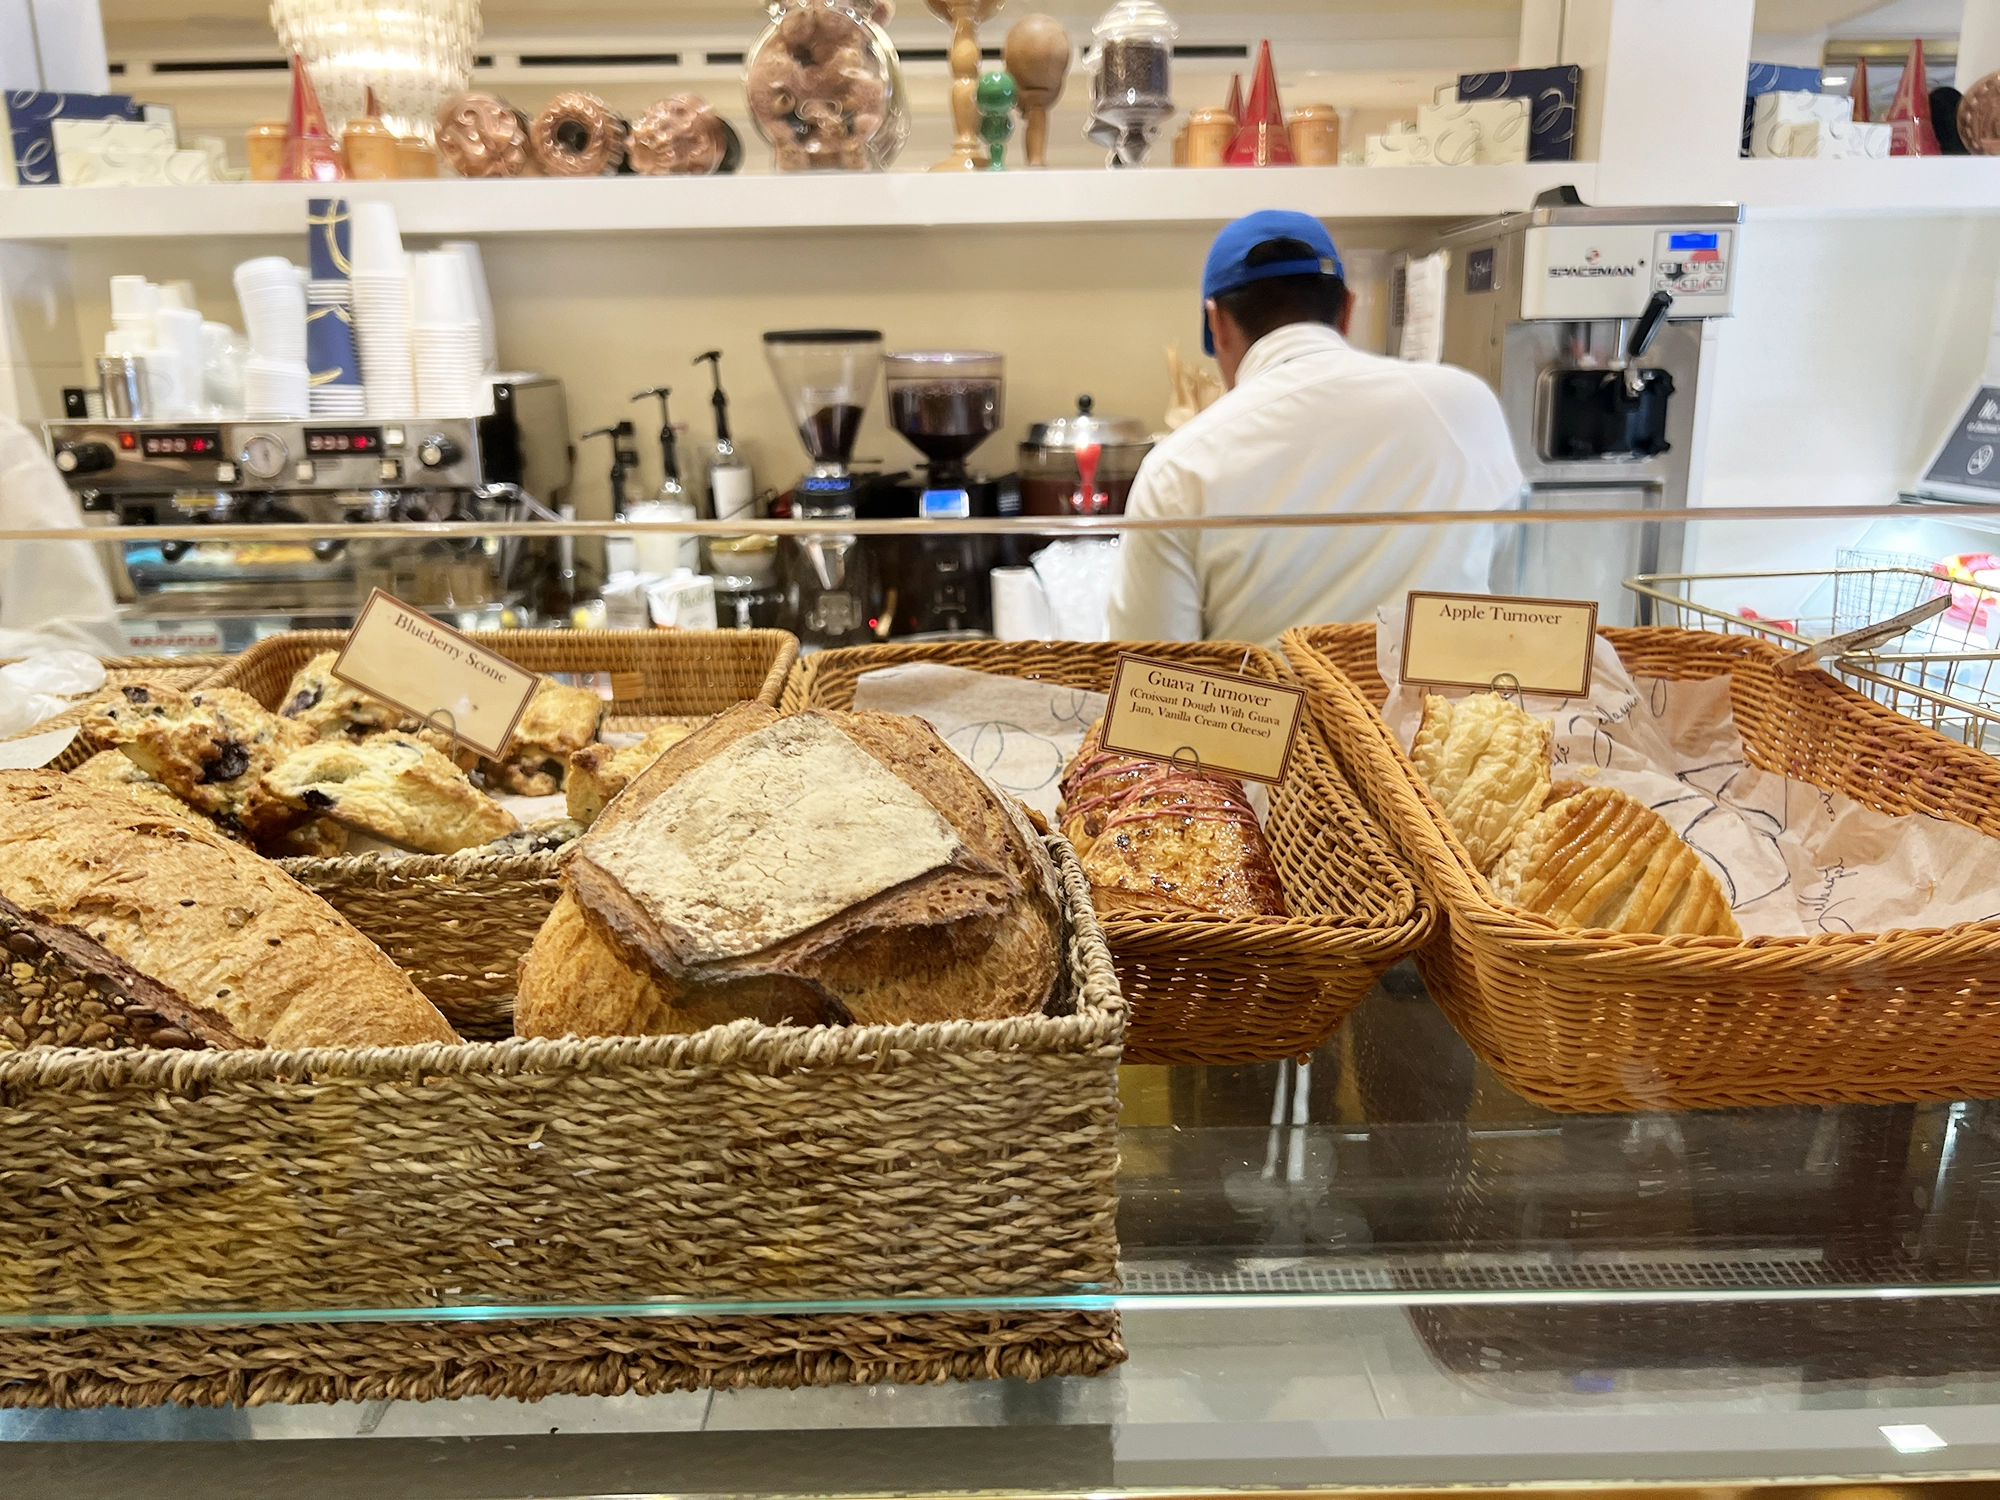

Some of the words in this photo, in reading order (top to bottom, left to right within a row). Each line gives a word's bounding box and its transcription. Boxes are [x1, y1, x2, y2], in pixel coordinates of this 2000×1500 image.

[1439, 604, 1485, 621] Apple
[1490, 606, 1562, 624] Turnover
[395, 614, 463, 660] Blueberry
[465, 653, 506, 684] Scone
[1129, 687, 1179, 706] (Croissant
[1182, 697, 1216, 714] Dough
[1220, 704, 1245, 720] With
[1248, 711, 1280, 725] Guava
[1148, 670, 1194, 692] Guava
[1200, 681, 1271, 707] Turnover
[1129, 701, 1155, 717] Jam,
[1158, 706, 1192, 723] Vanilla
[1194, 714, 1228, 730] Cream
[1231, 722, 1271, 738] Cheese)
